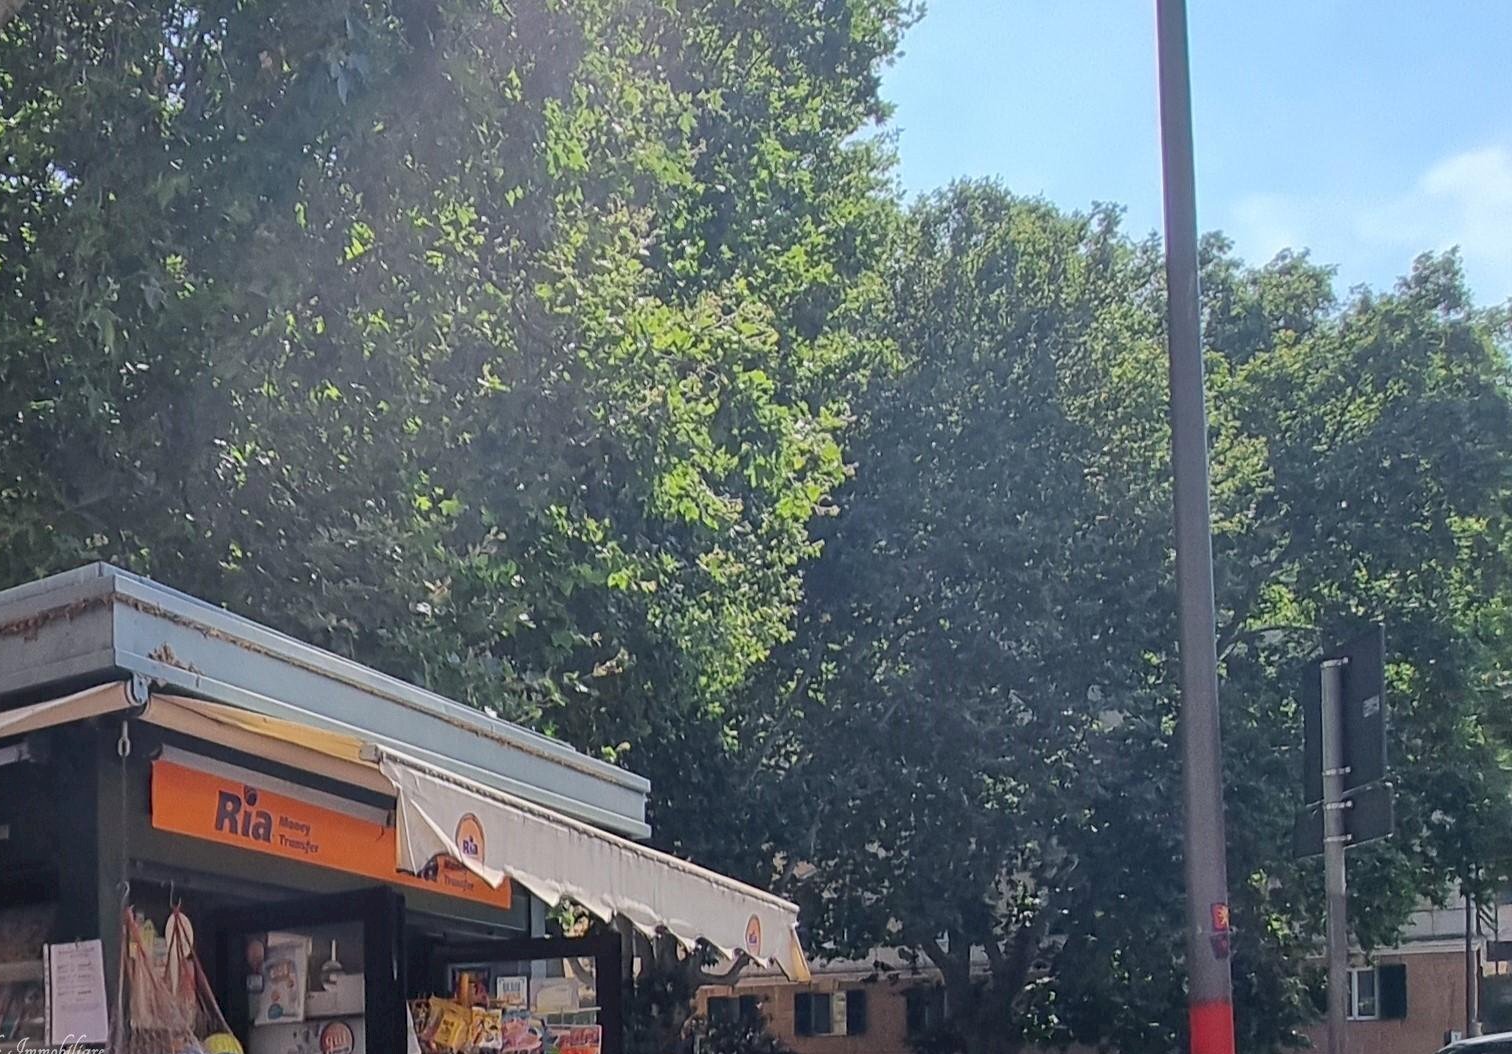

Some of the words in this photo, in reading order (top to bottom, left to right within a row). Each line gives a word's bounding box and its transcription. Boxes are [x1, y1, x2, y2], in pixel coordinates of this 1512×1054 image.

[215, 785, 273, 844] Ria
[279, 815, 311, 837] Money
[279, 834, 320, 854] Transfer
[462, 835, 479, 855] Ria
